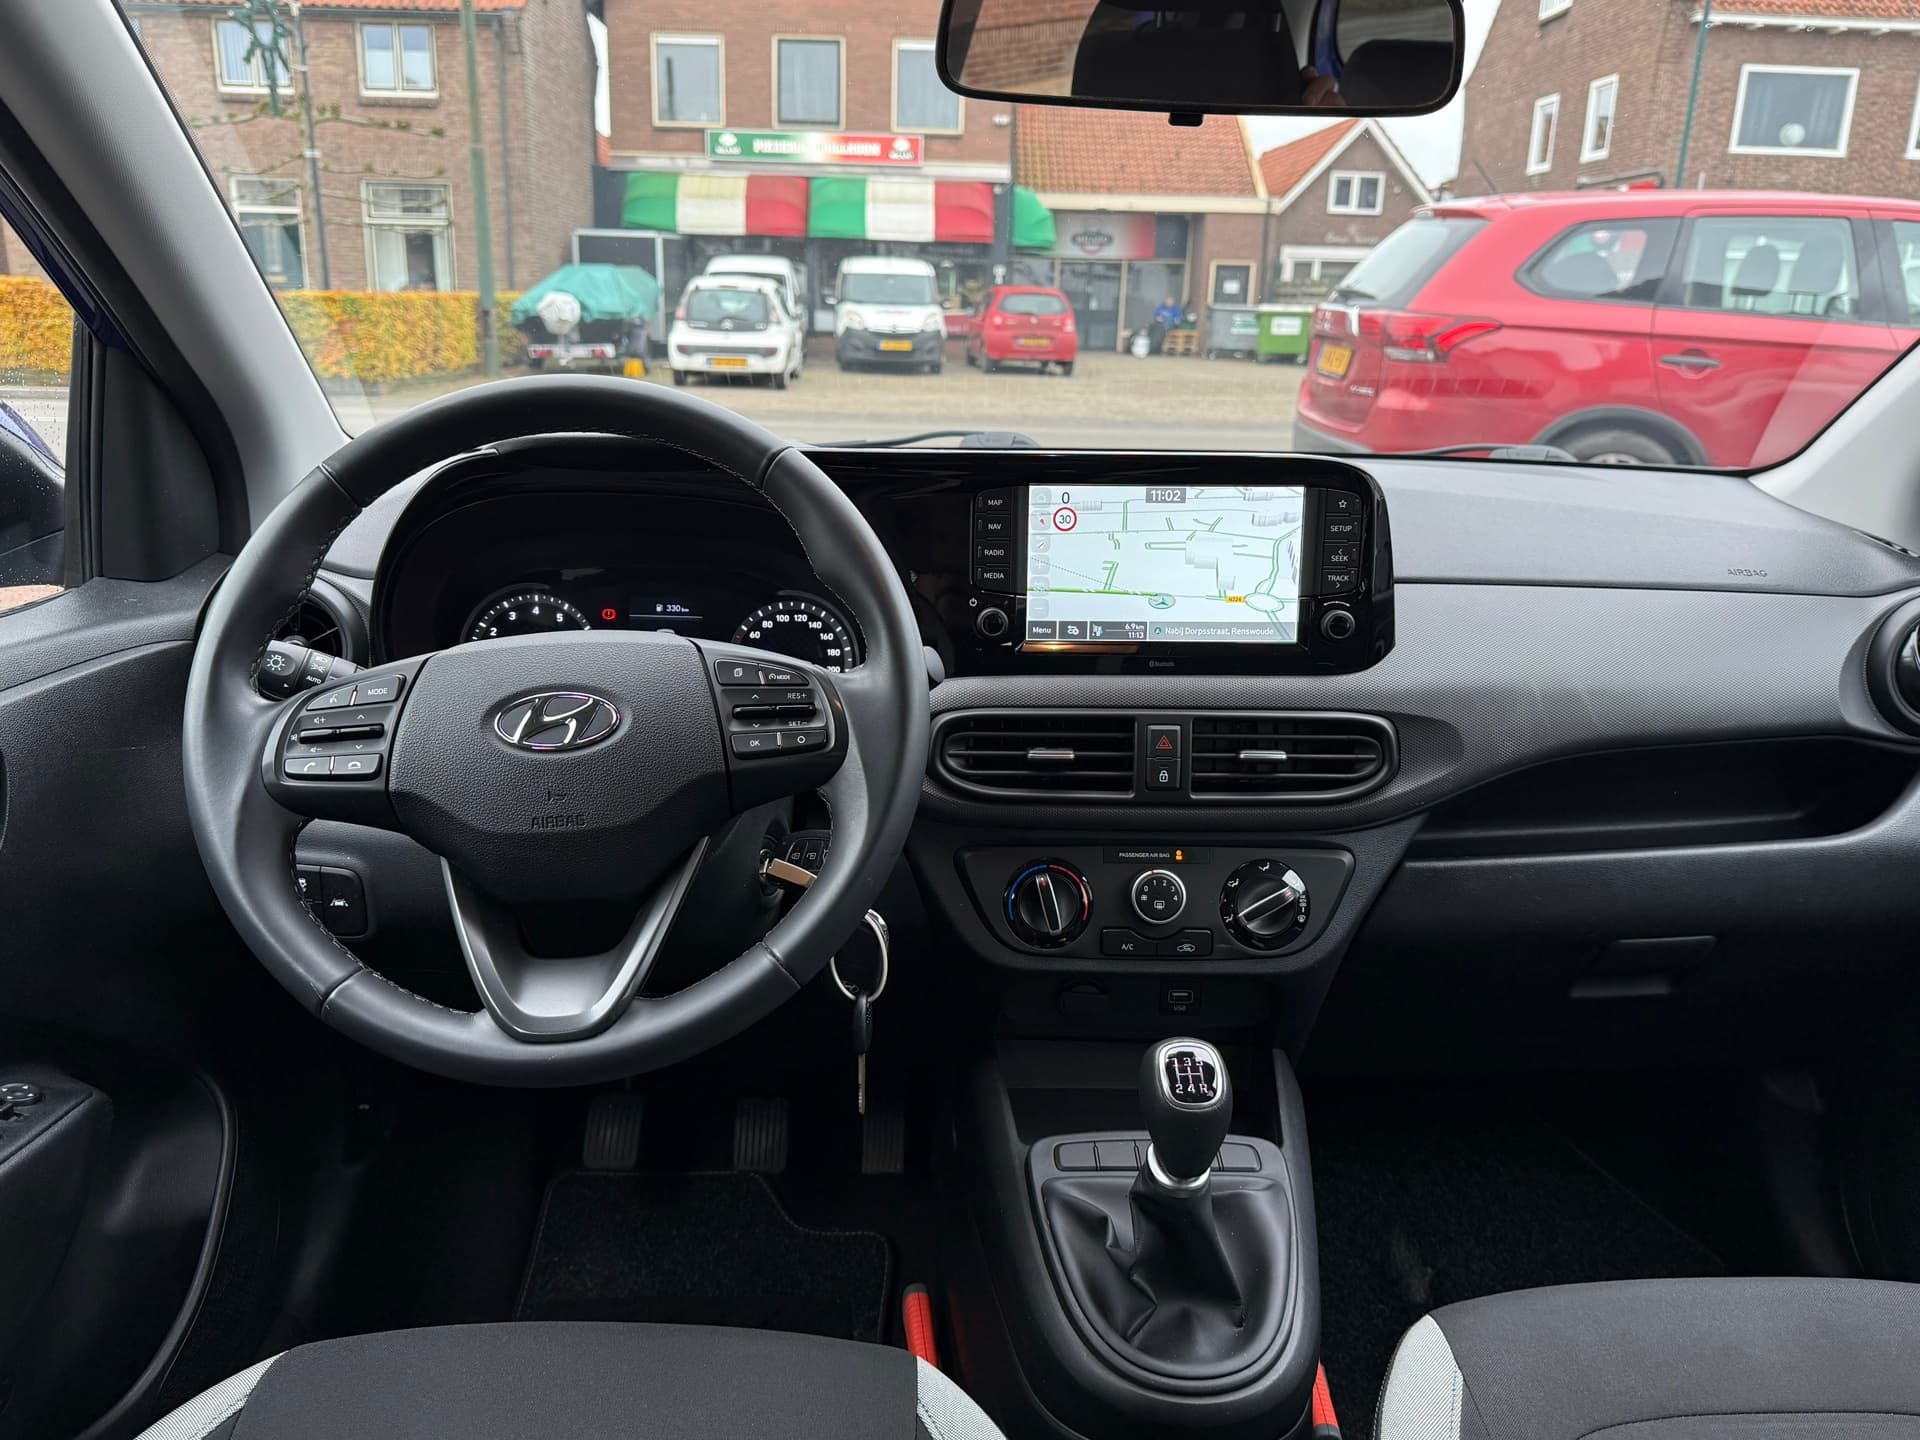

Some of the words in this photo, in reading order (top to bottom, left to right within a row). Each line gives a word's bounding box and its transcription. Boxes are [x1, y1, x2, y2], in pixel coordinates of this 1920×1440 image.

[1061, 491, 1070, 504] 0
[1150, 489, 1181, 502] 11:02
[1059, 514, 1072, 525] 30
[988, 522, 1002, 530] NAV
[1727, 568, 1768, 578] AIRBAG
[489, 627, 497, 636] 2
[508, 611, 516, 621] 3
[532, 606, 540, 615] 4
[556, 613, 564, 622] 5
[749, 631, 760, 639] 60
[762, 620, 773, 629] 80
[776, 614, 790, 622] 100
[794, 614, 808, 622] 120
[808, 621, 823, 629] 140
[827, 648, 841, 656] 180
[1032, 626, 1052, 634] Menu
[1165, 626, 1184, 636] Nabij
[1231, 626, 1274, 635] Renswoude
[306, 675, 322, 684] AUTO
[367, 687, 388, 696] MODE
[530, 815, 586, 830] AIRBAG
[1121, 943, 1134, 951] A/C
[1183, 1057, 1192, 1067] 3
[1175, 1083, 1184, 1094] 2
[1187, 1083, 1196, 1094] 4
[1199, 1083, 1208, 1094] R
